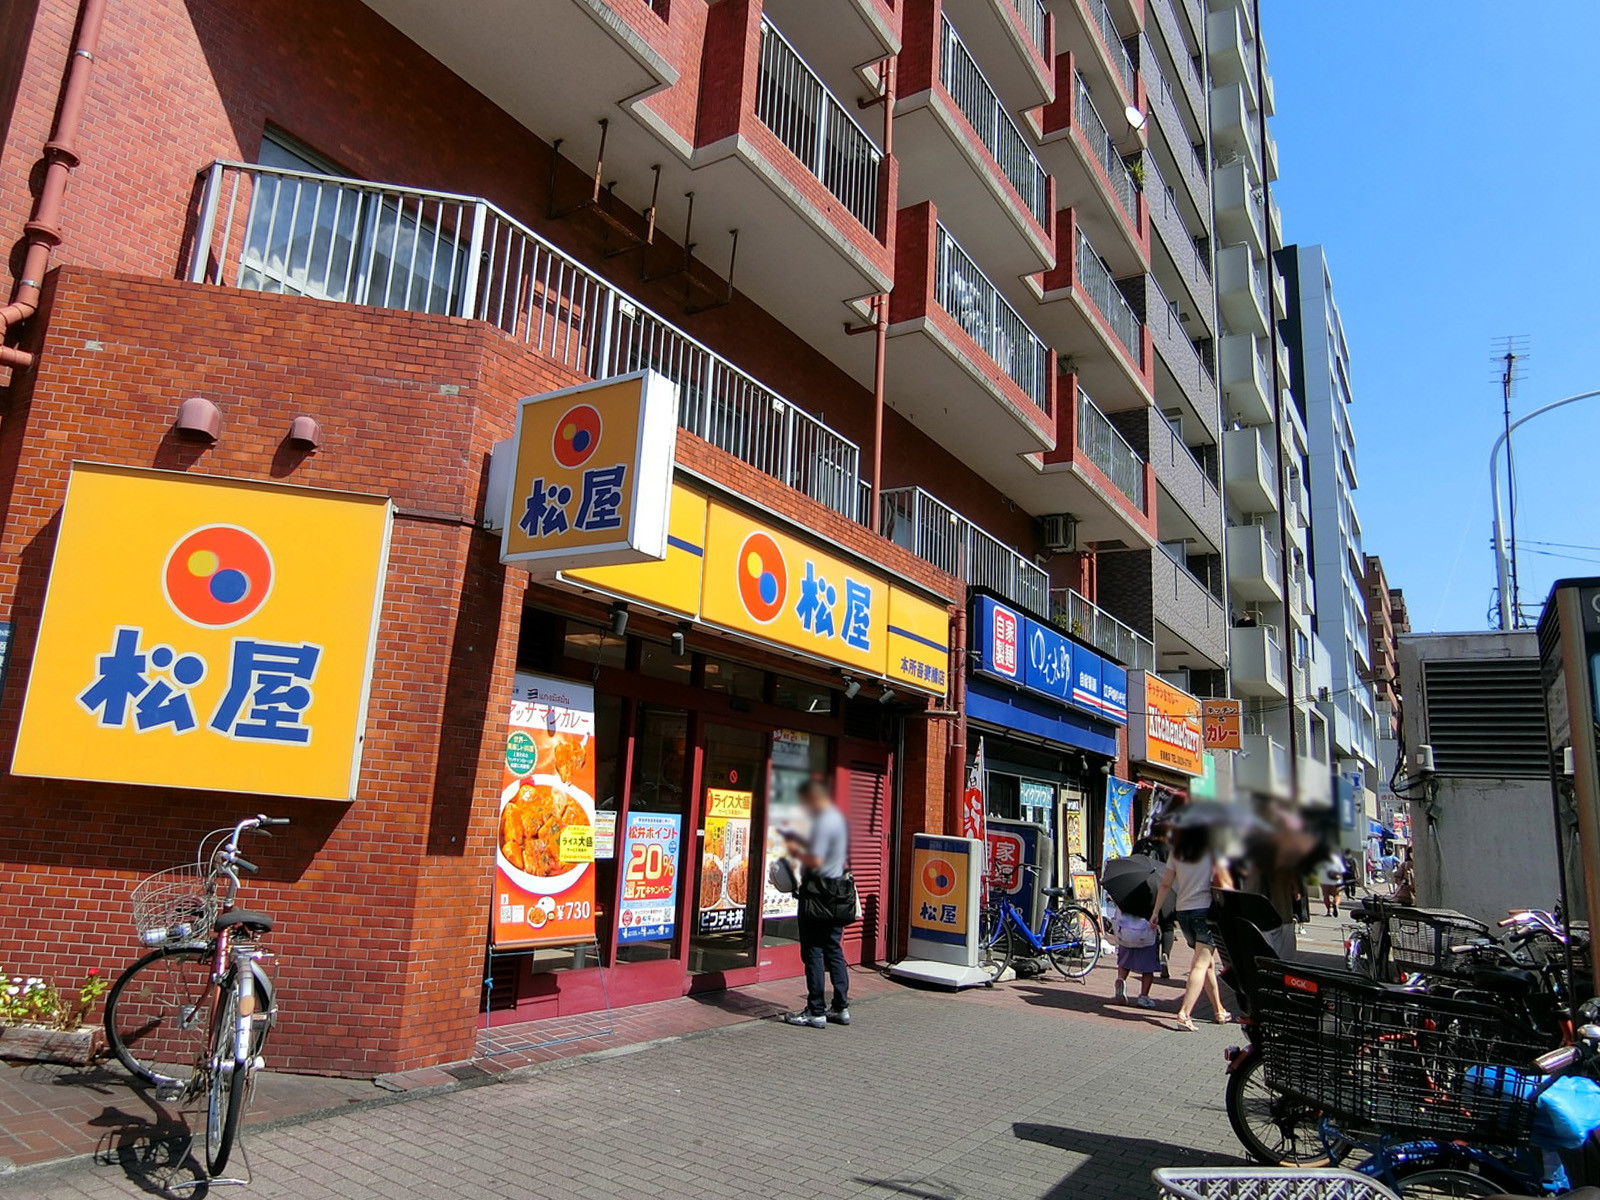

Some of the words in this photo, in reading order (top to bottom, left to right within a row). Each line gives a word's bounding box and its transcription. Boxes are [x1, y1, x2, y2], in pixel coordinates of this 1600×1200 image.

[519, 464, 626, 539] 松屋
[795, 559, 872, 653] 松屋
[900, 656, 945, 686] 本所吾妻橋店
[76, 625, 324, 747] 松屋
[1207, 725, 1238, 742] カレー
[714, 793, 751, 809] ライス大盛
[562, 836, 593, 847] ライス大盛
[628, 826, 678, 839] 松弁ポイント
[625, 843, 675, 880] 20%
[556, 900, 590, 920] ¥730
[701, 908, 744, 927] ビフテキ丼
[919, 901, 957, 925] 松屋
[1290, 978, 1307, 989] OGK
